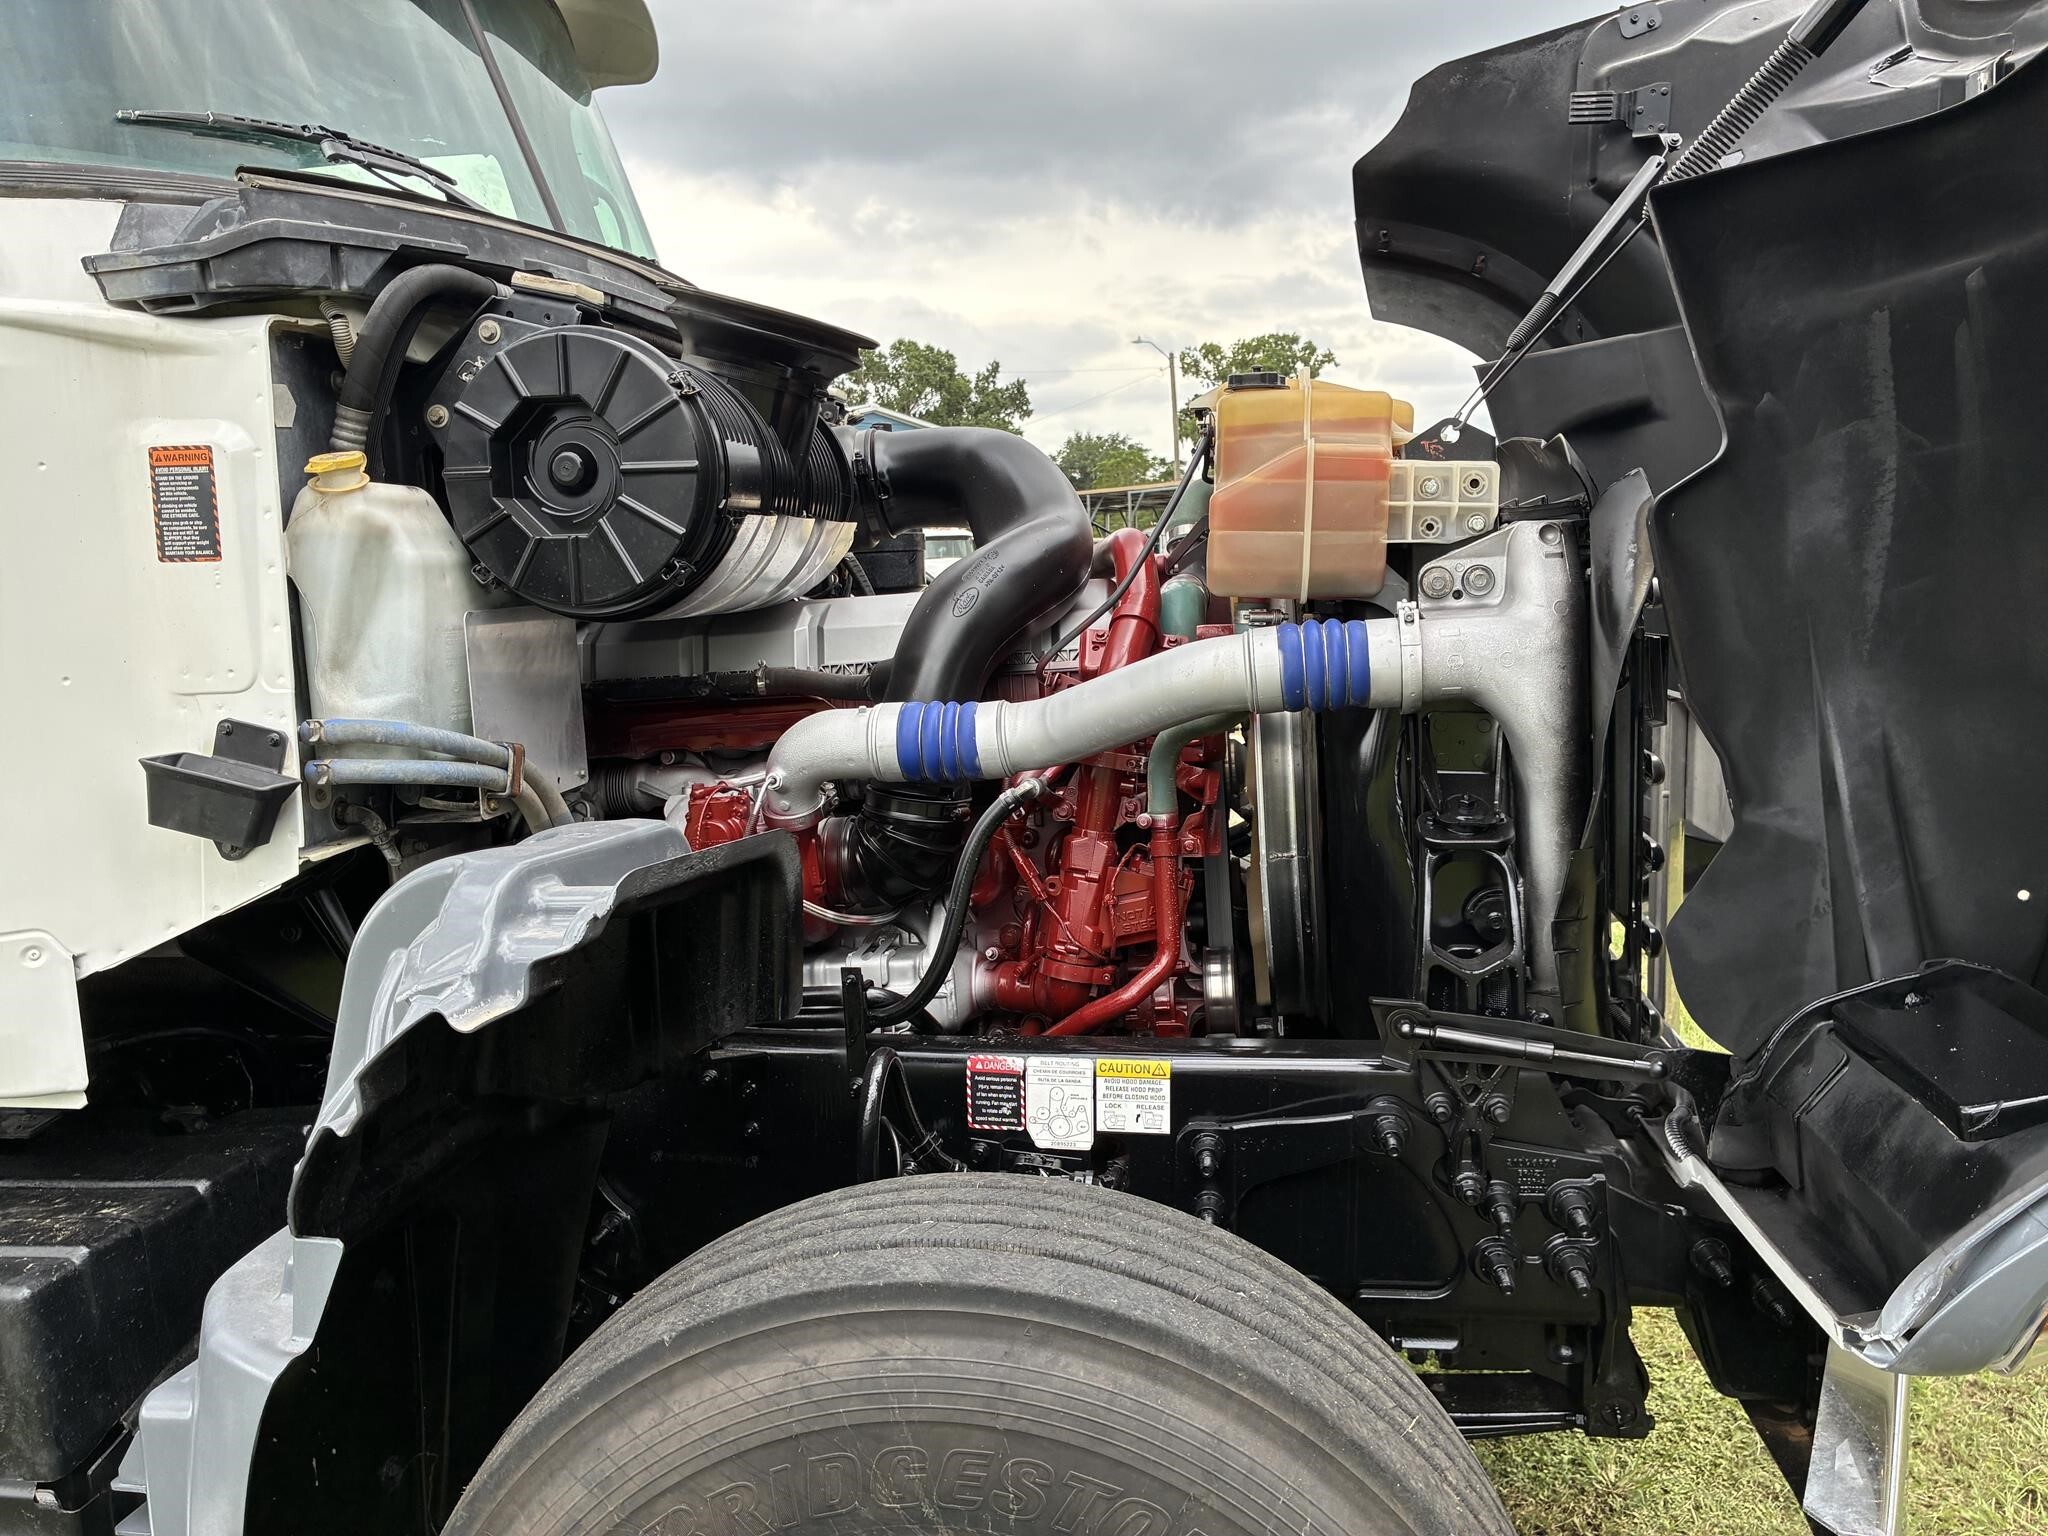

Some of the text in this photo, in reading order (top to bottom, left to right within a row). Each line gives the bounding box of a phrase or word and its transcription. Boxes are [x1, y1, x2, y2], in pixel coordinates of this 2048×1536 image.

[163, 453, 207, 462] WARNING
[1117, 908, 1143, 921] NOT
[1122, 918, 1155, 933] STEP
[984, 1062, 1017, 1071] DANGER
[1099, 1063, 1150, 1074] CAUTION
[638, 1445, 1207, 1536] RIDGESTO
